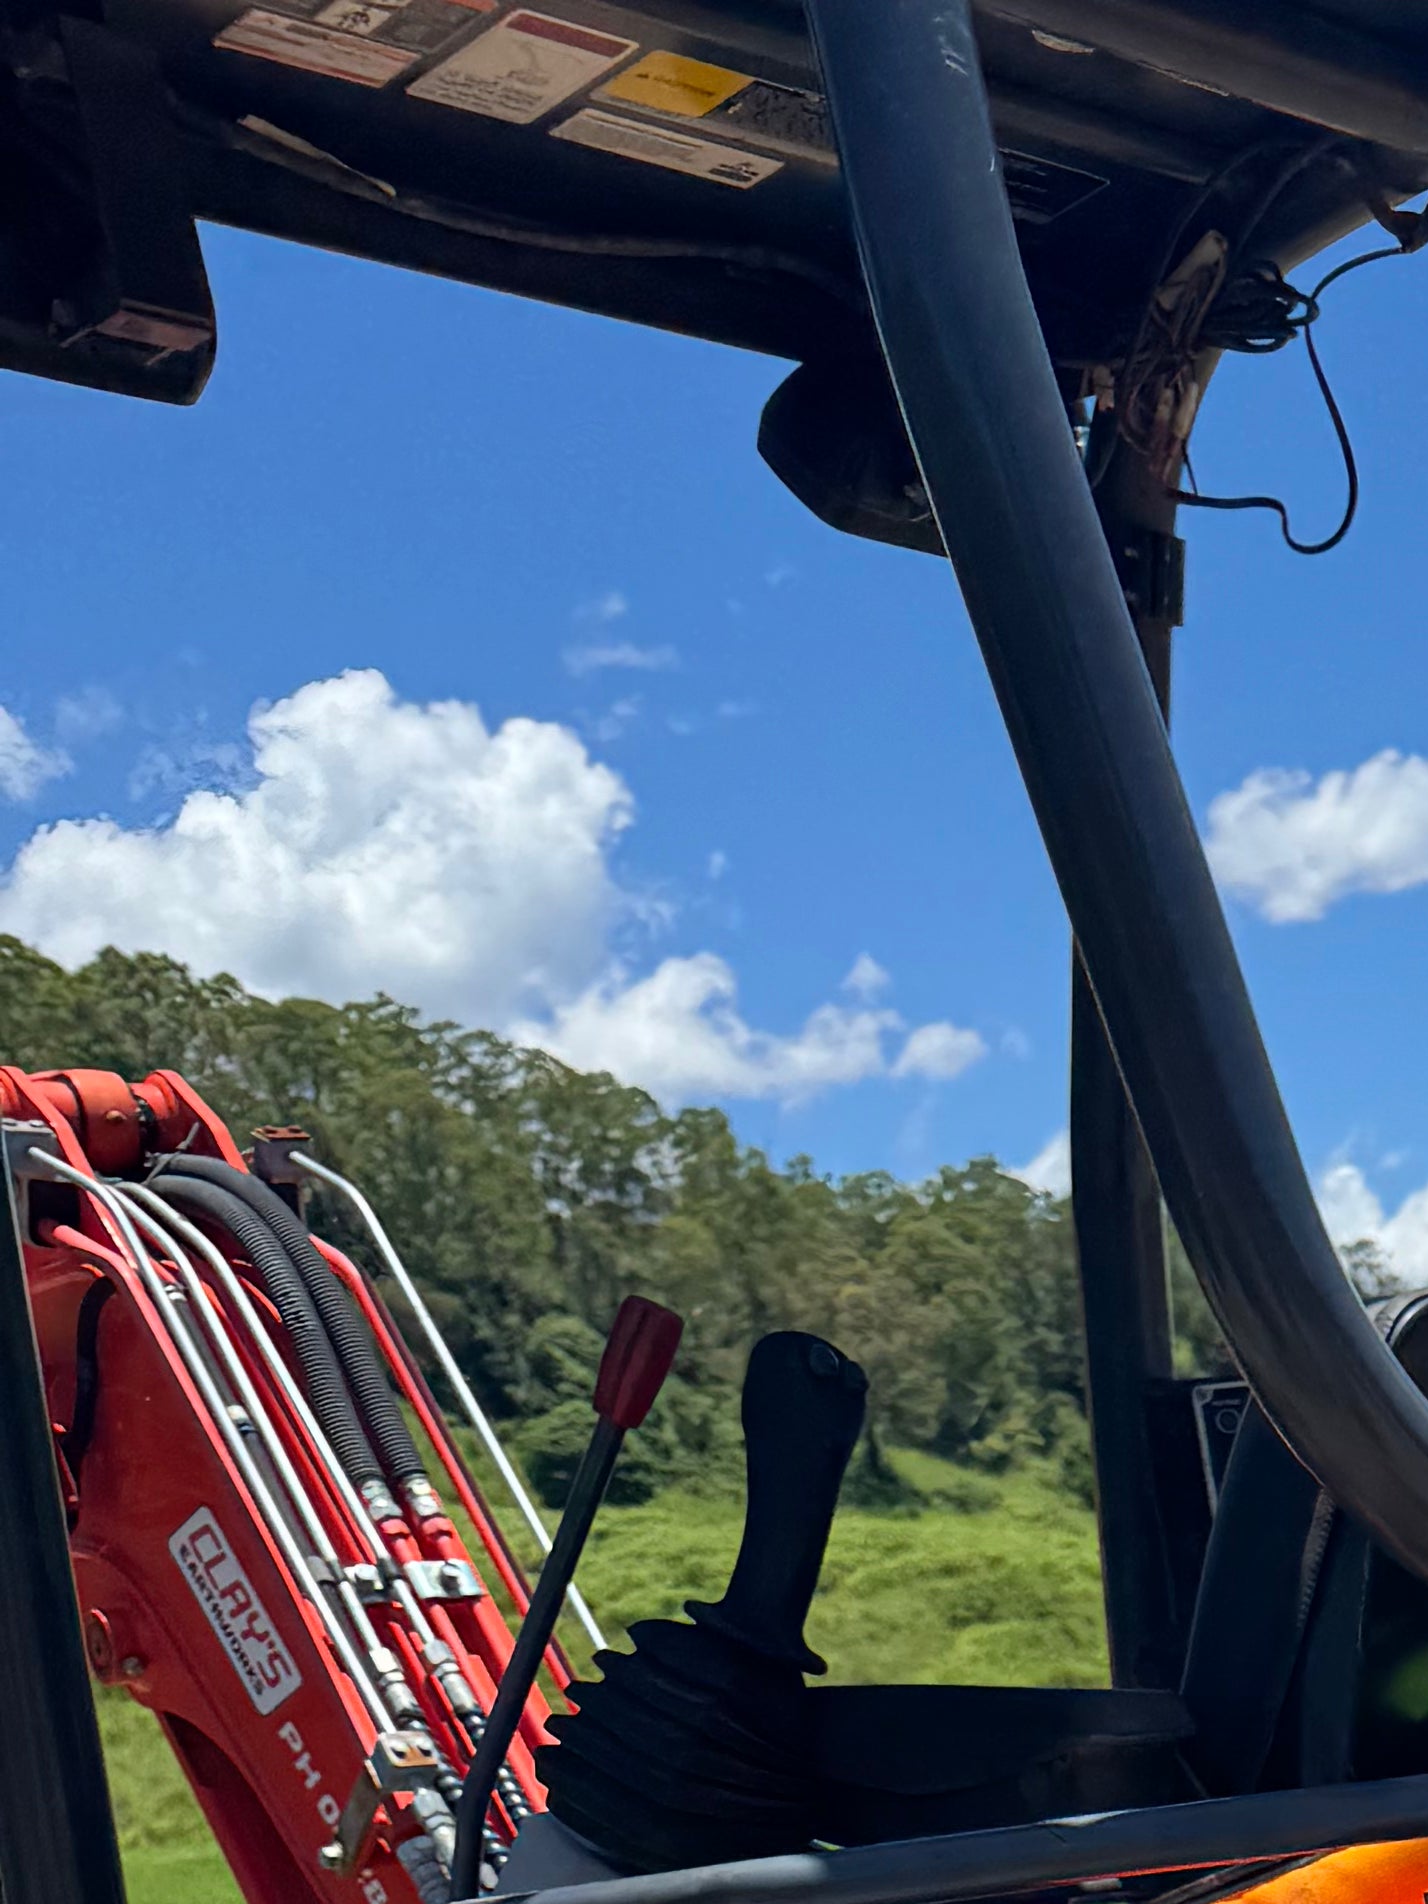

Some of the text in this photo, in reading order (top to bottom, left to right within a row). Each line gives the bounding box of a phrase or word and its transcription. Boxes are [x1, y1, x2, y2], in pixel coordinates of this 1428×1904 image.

[178, 1543, 266, 1696] EARTHWORKS
[188, 1524, 292, 1689] CLAY'S
[278, 1721, 322, 1789] PH
